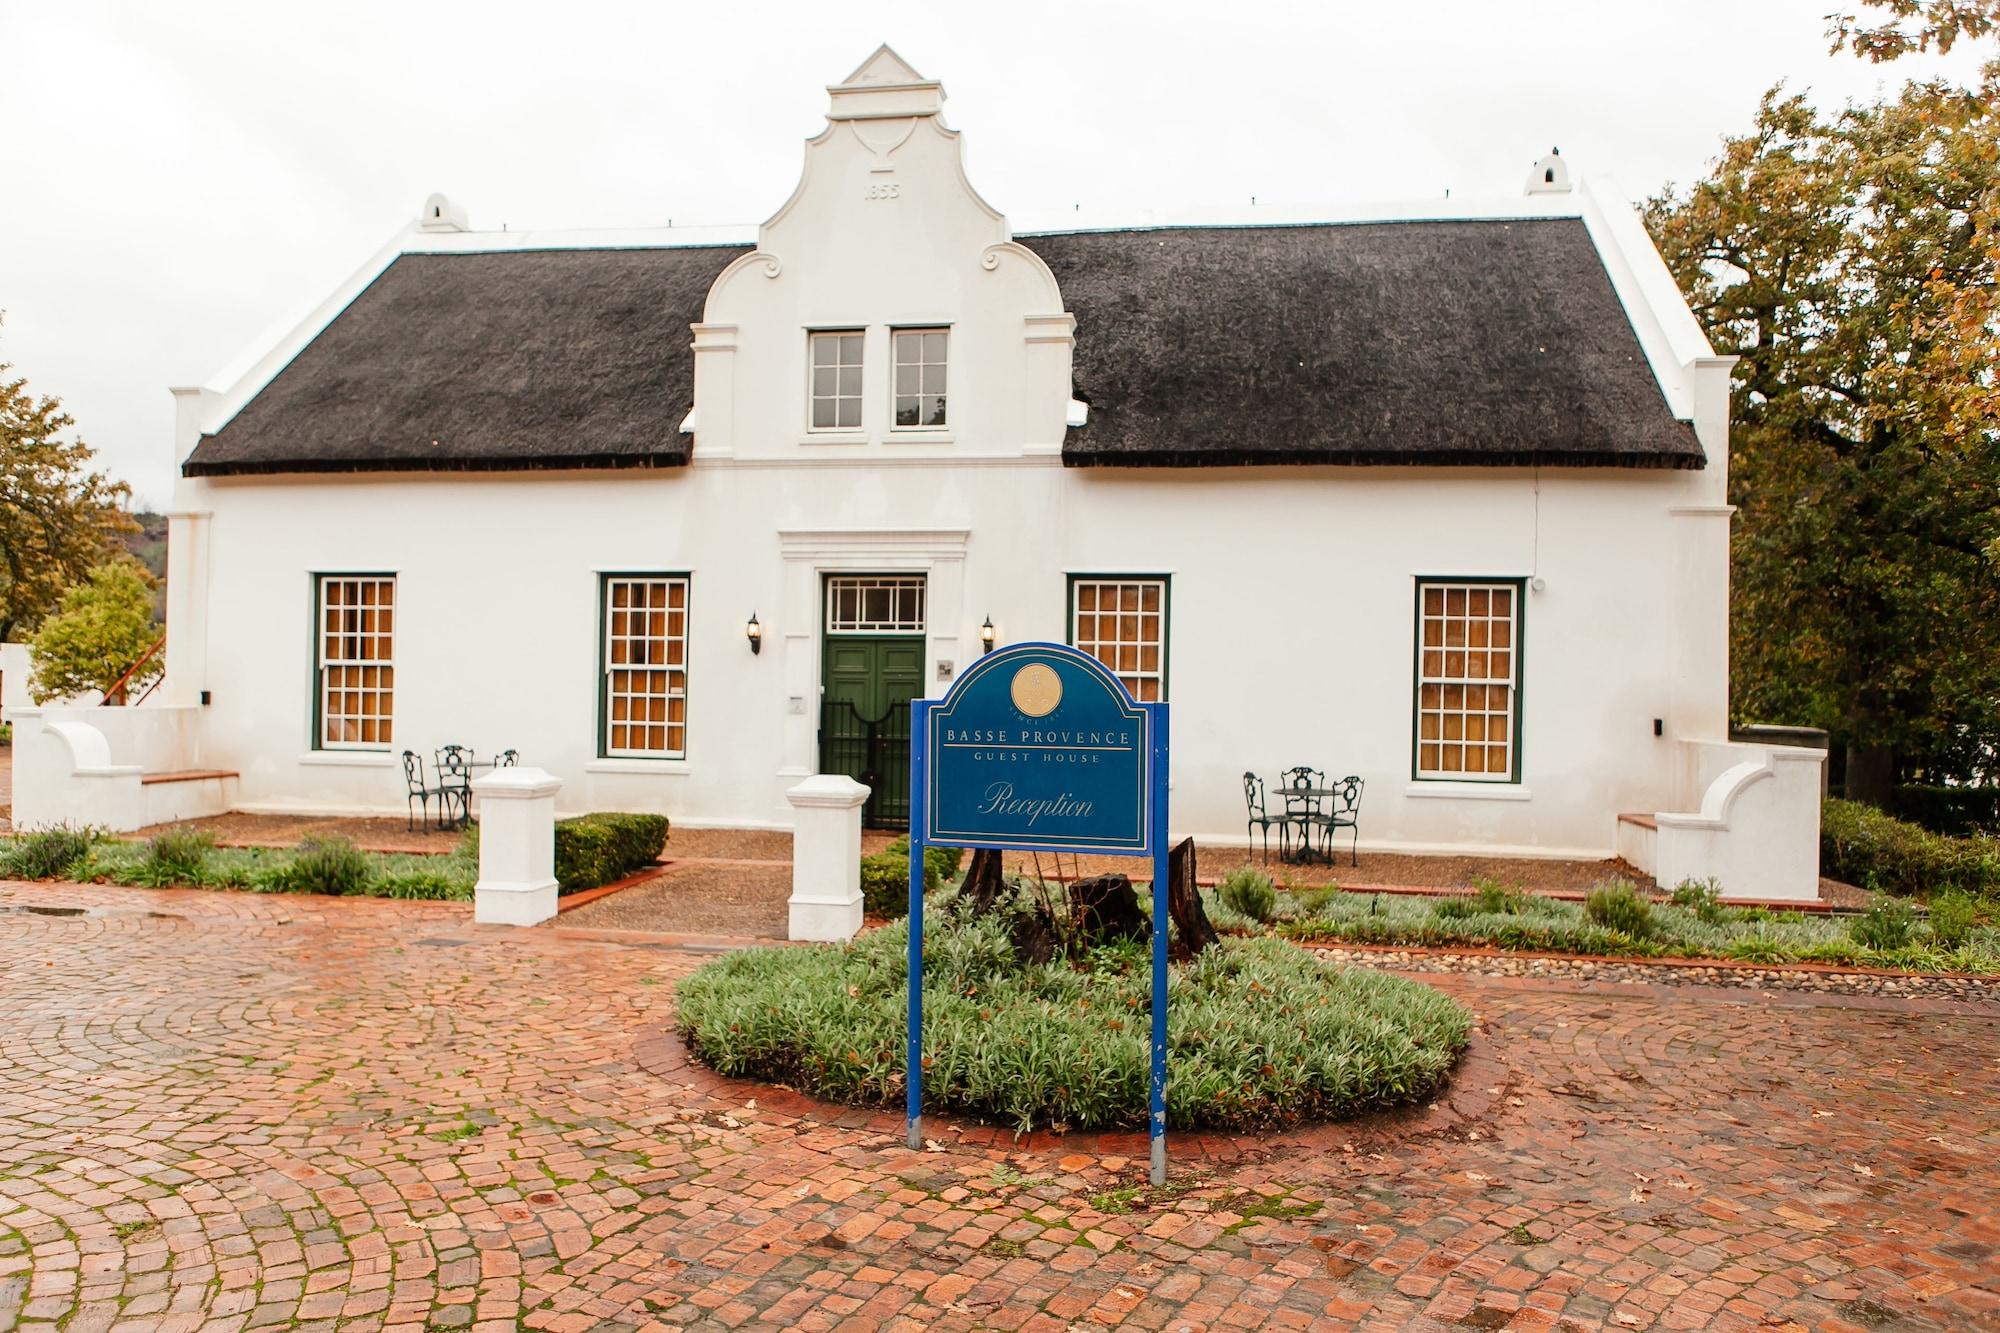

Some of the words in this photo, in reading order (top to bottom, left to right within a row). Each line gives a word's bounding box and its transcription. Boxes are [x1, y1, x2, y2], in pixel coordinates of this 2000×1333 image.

[947, 729, 1007, 742] BASSE
[1021, 731, 1129, 744] PROVENCE
[974, 752, 1030, 762] GUEST
[1043, 753, 1100, 763] HOUSE
[977, 781, 1095, 827] Reception
